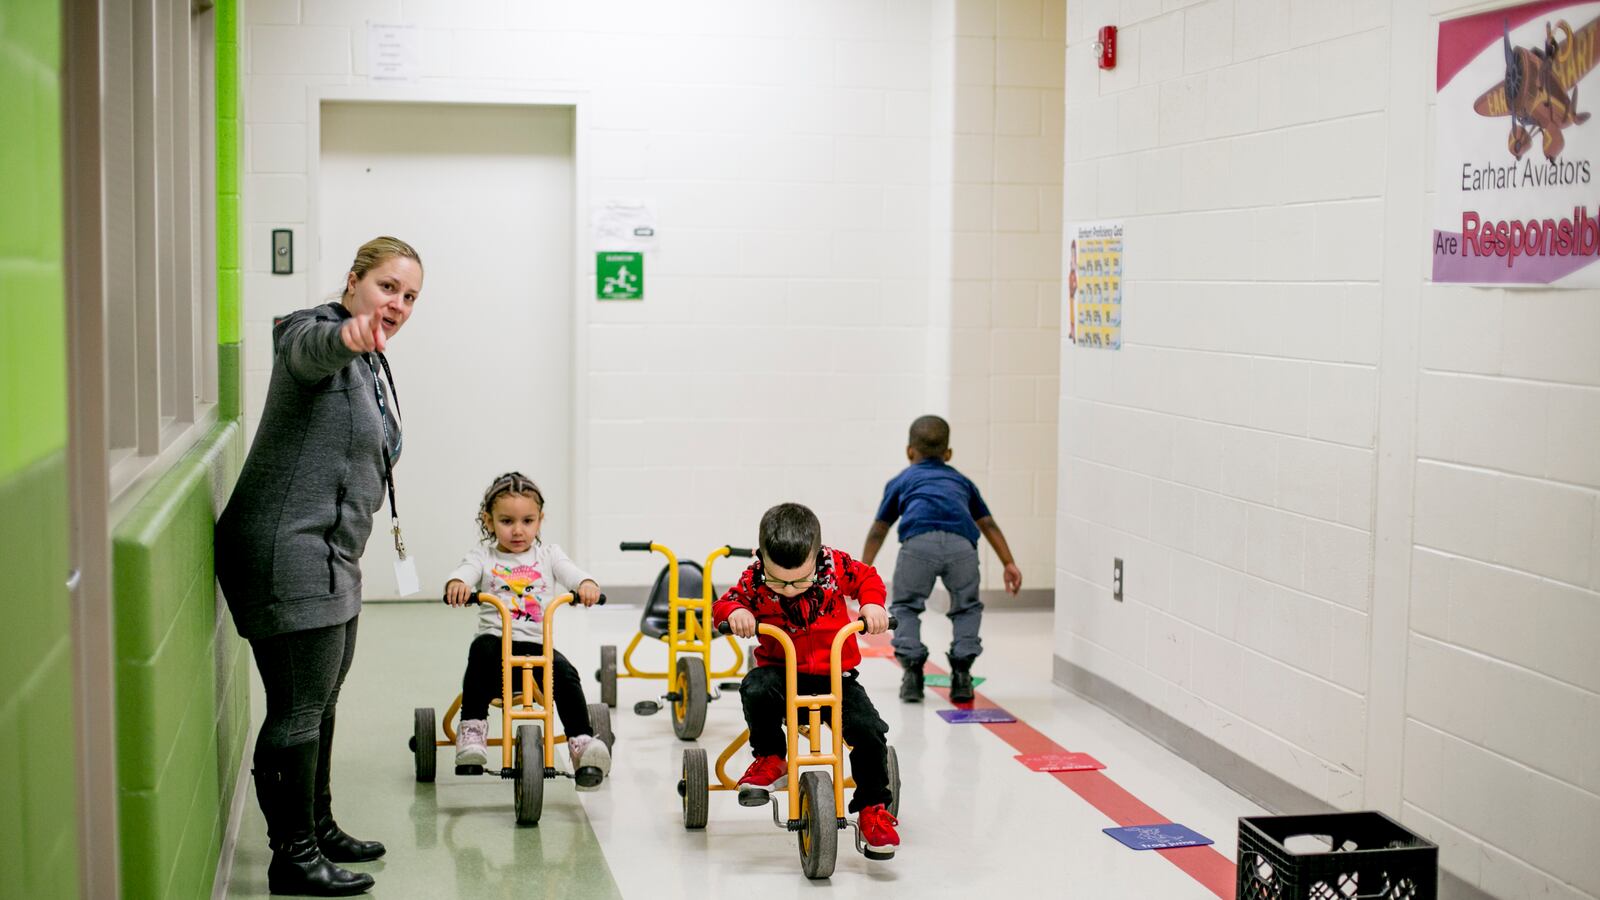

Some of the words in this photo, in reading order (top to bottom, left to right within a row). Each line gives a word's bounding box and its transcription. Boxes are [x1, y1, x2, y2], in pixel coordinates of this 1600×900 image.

[1461, 161, 1517, 191] Earhart
[1521, 156, 1591, 187] Aviators
[1435, 232, 1458, 255] Are
